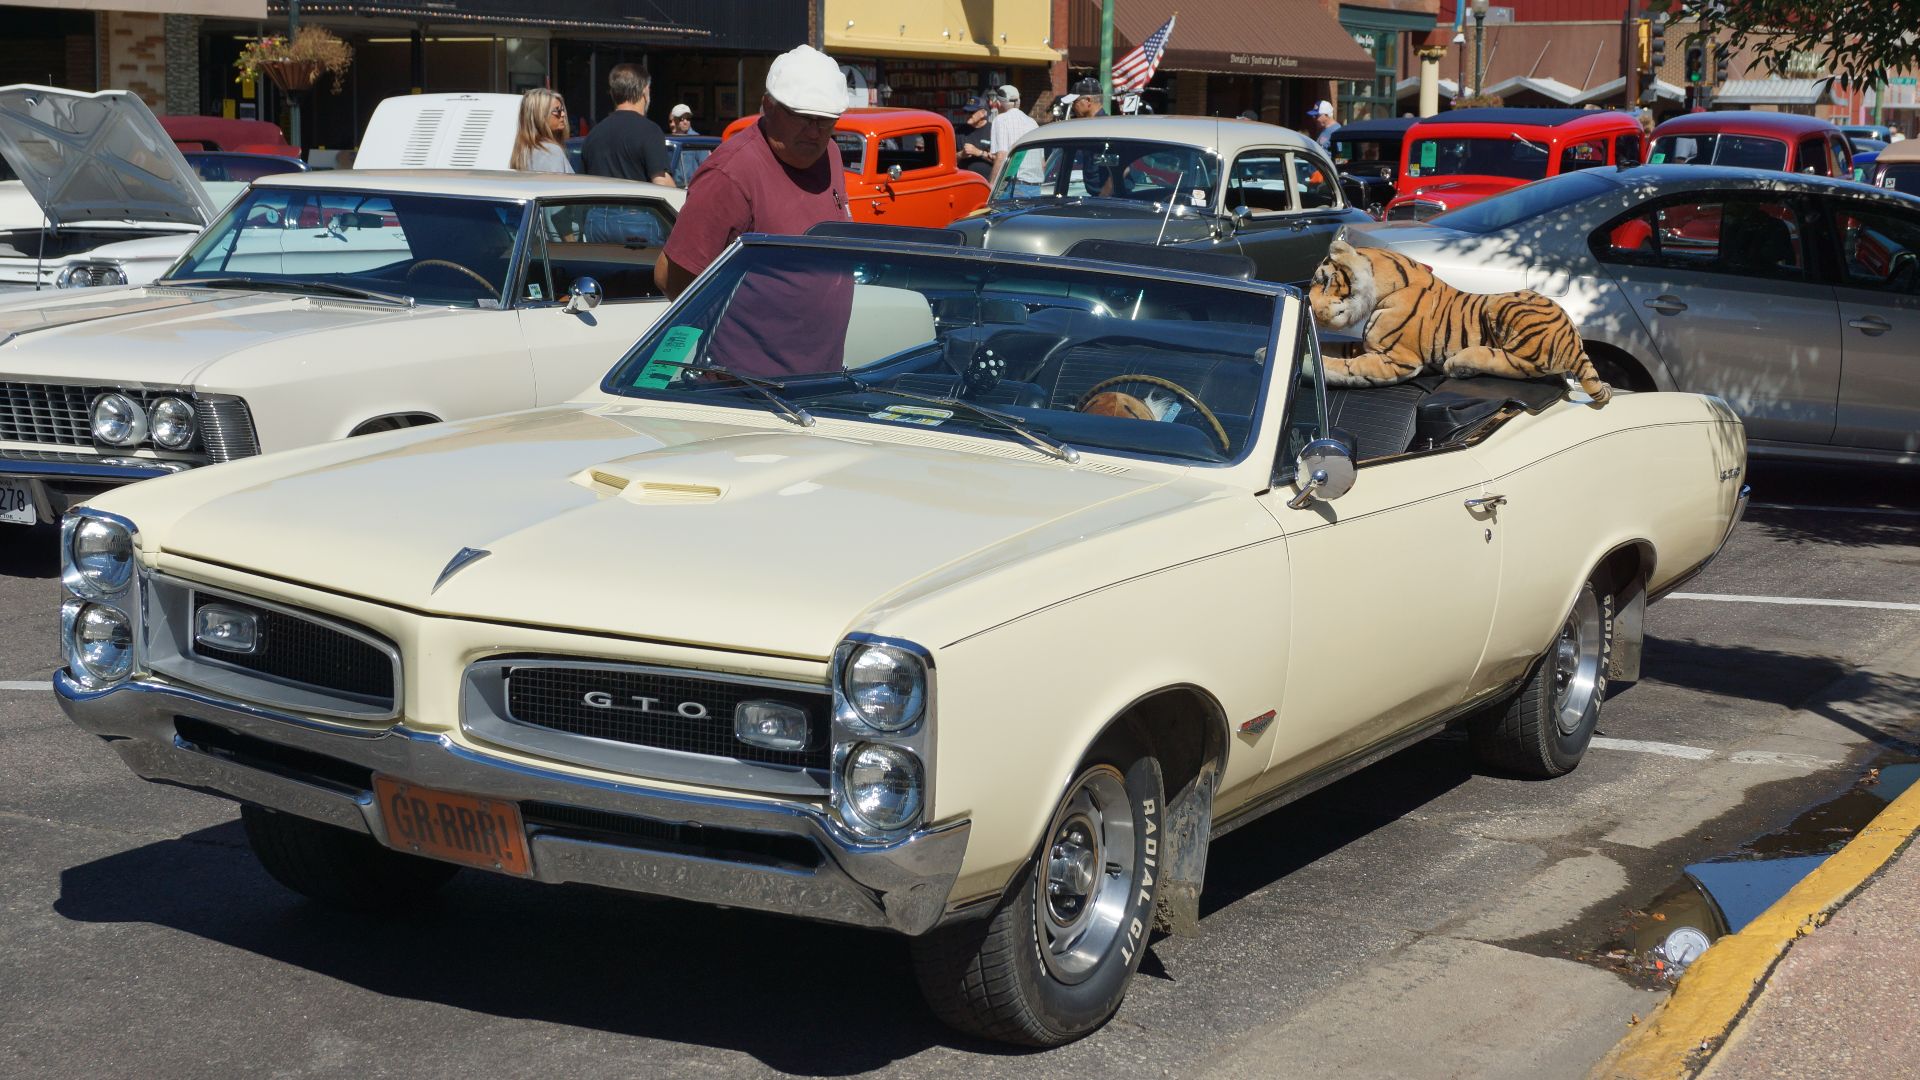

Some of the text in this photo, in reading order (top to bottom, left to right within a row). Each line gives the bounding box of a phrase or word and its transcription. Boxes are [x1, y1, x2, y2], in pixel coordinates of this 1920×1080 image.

[1602, 594, 1612, 669] RADIAL
[583, 691, 707, 719] GTO
[1121, 799, 1157, 967] RADIAL G/T
